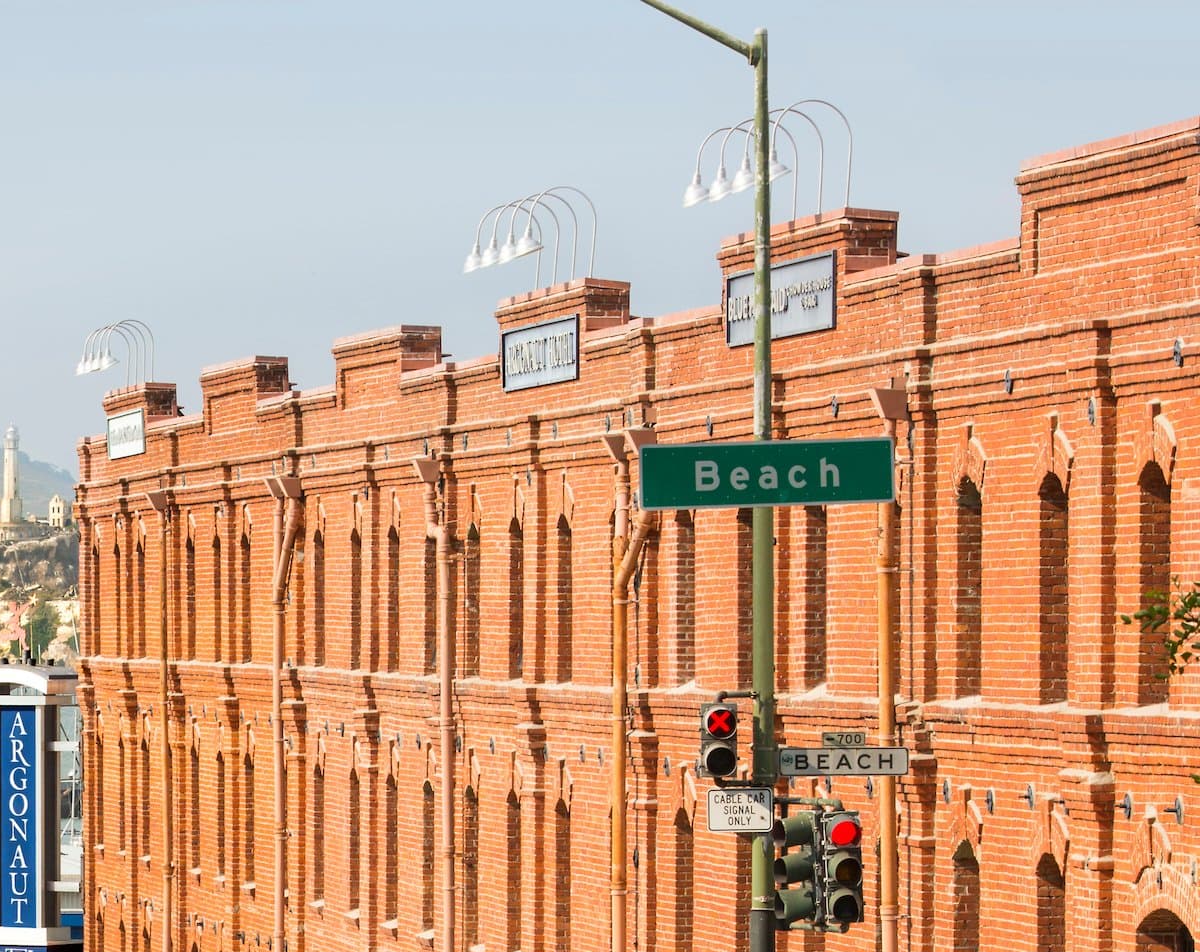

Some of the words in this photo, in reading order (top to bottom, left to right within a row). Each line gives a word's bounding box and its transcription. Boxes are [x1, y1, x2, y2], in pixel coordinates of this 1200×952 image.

[694, 457, 840, 492] Beach
[837, 734, 862, 744] 700
[794, 753, 893, 770] BEACH
[713, 794, 742, 804] CABLE
[747, 792, 766, 803] CAR
[723, 806, 755, 815] SIGNAL
[9, 710, 31, 924] ARGONAUT
[727, 816, 751, 826] ONLY
